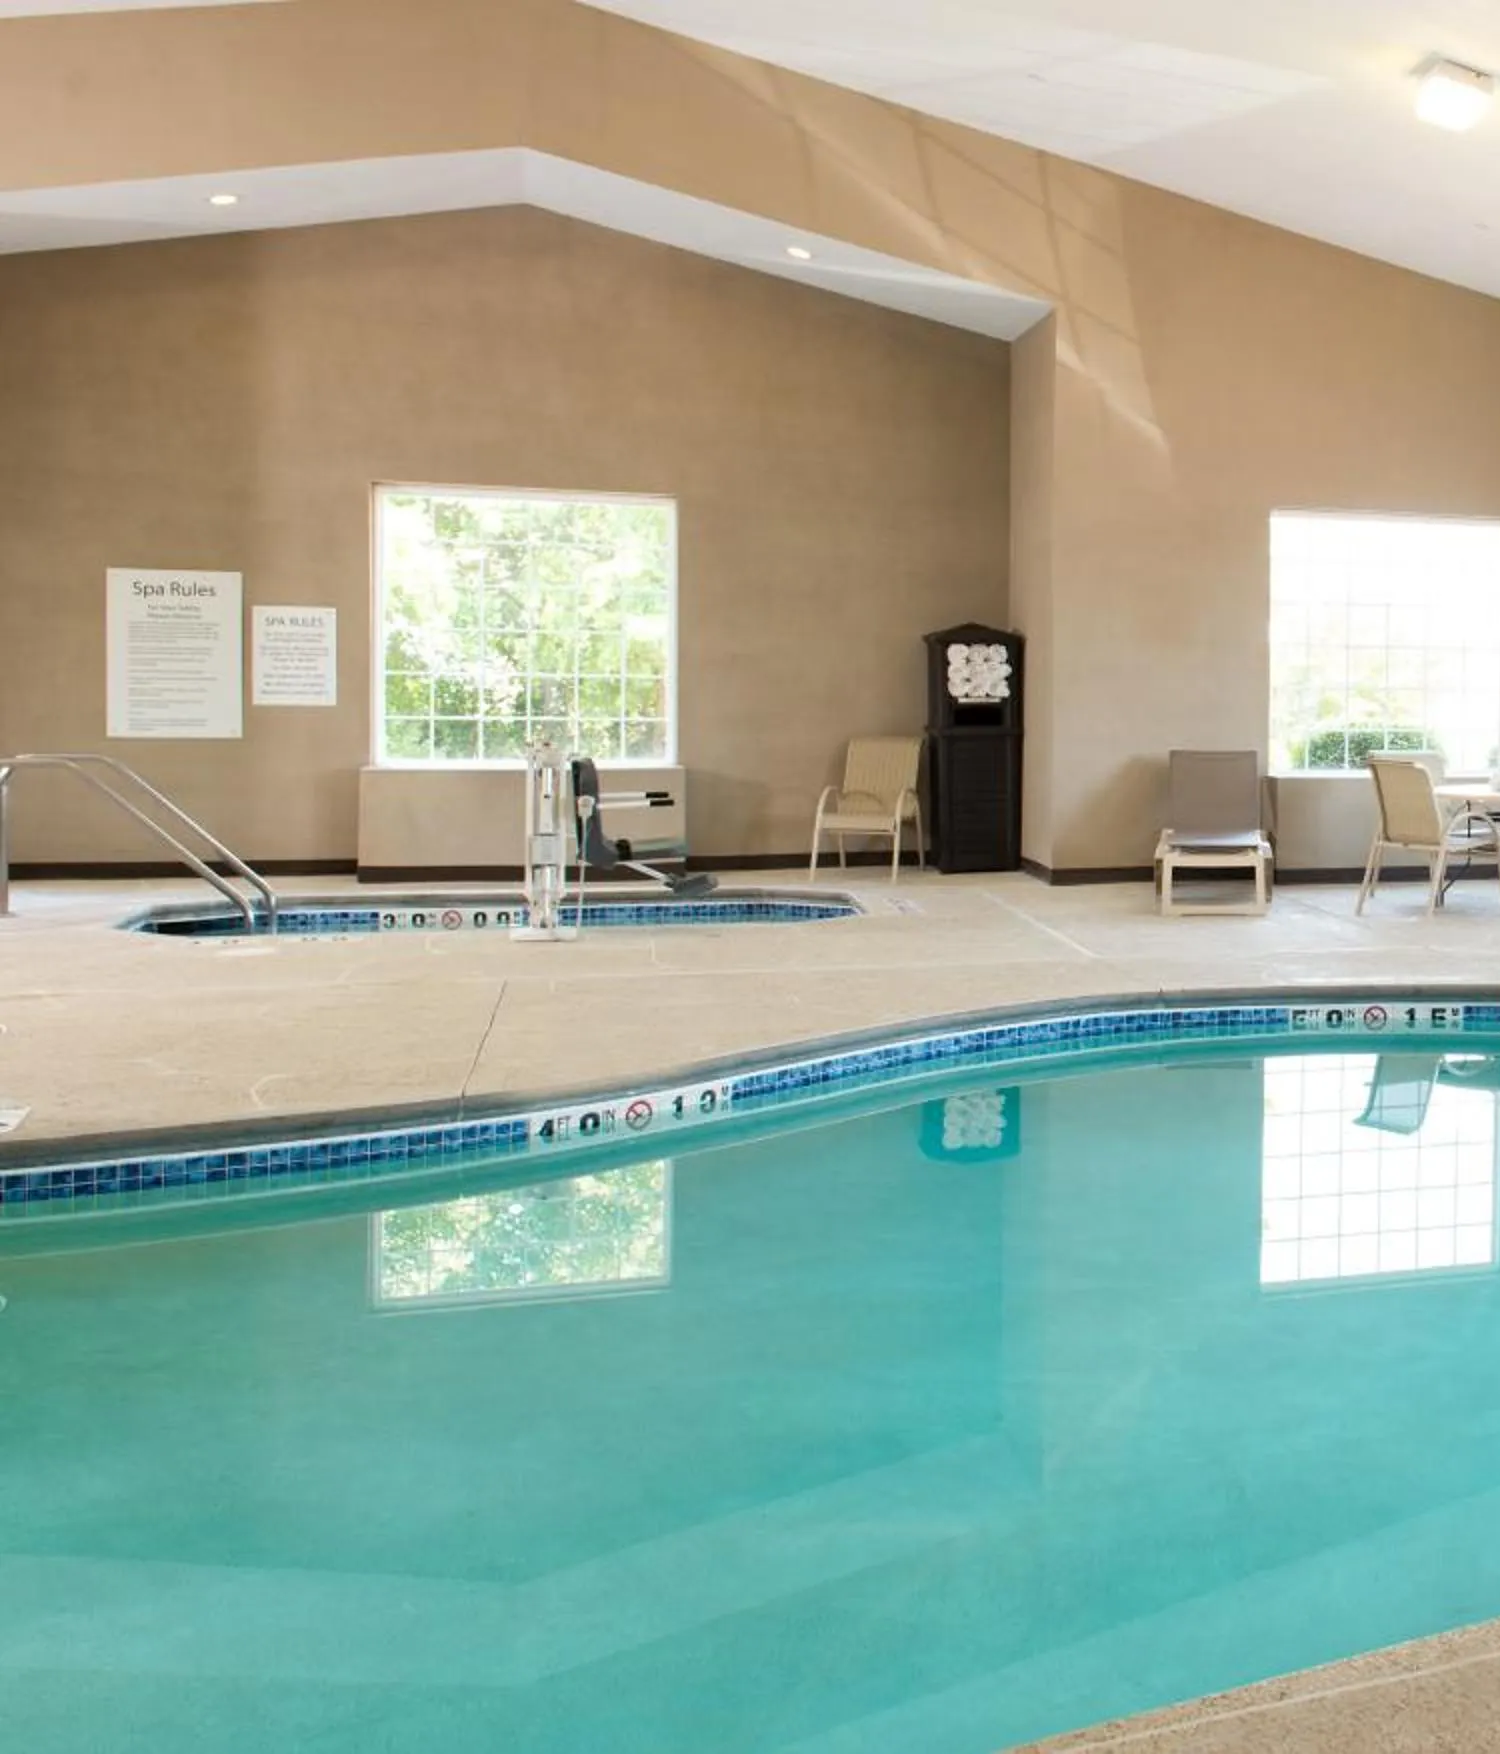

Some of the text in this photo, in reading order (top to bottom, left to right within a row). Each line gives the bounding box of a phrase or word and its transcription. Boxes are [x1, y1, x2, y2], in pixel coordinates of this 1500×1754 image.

[132, 581, 217, 599] Spa Rules
[265, 615, 324, 628] SPA RULES
